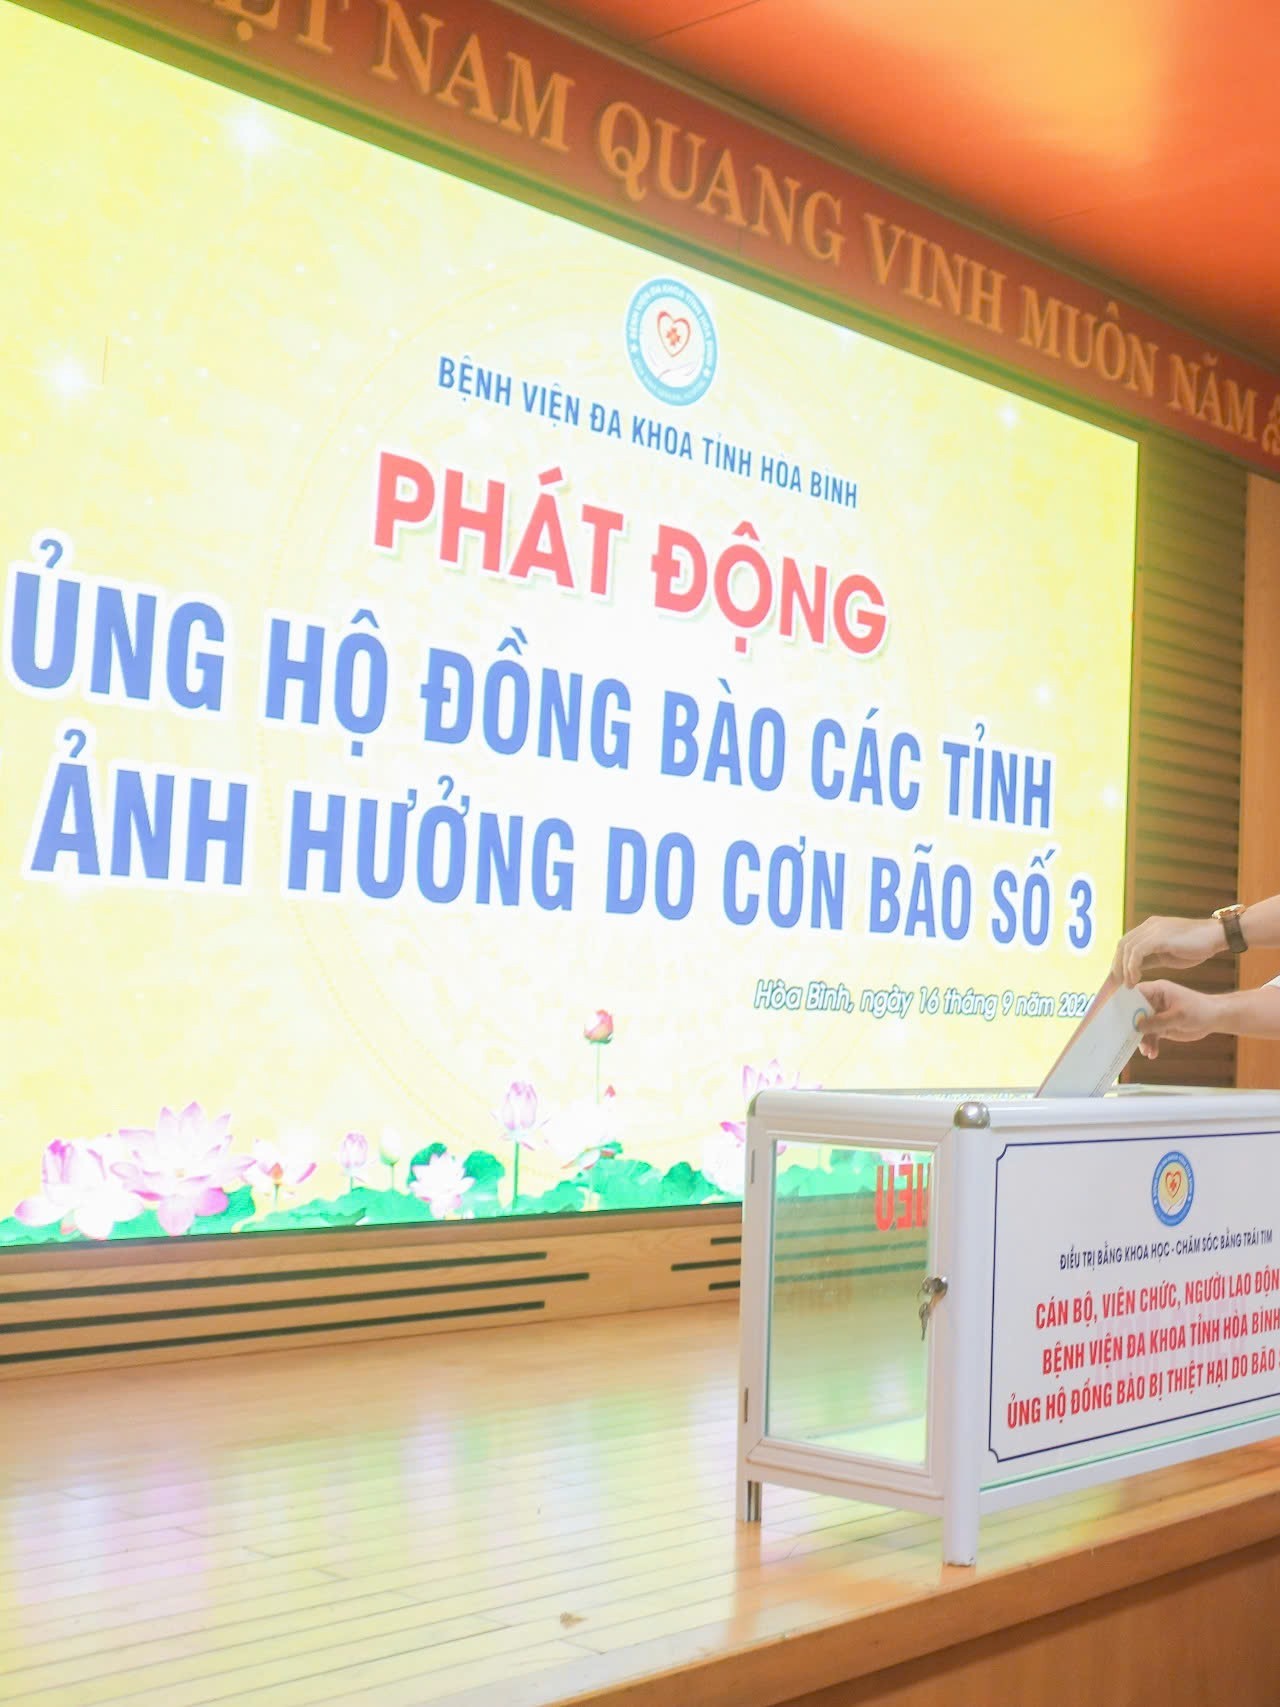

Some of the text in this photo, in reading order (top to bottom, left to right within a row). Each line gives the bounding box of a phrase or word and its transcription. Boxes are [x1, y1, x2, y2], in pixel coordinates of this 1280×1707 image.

[371, 0, 576, 151] NAM
[599, 101, 846, 266] QUANG
[863, 212, 1007, 334] VINH
[1018, 301, 1159, 397] MUÔN
[1168, 351, 1257, 443] NĂM
[438, 354, 858, 509] BỆNH VIỆN ĐA KHOA TỈNH HÒA BÌNH
[374, 452, 887, 654] PHÁT ĐỘNG
[11, 538, 1052, 829] ỦNG HỘ ĐỒNG BÀO CÁC TỈNH
[31, 729, 1092, 949] ẢNH HƯỞNG DO CƠN BÃO SỐ 3
[753, 979, 802, 1010] Hòa
[806, 981, 854, 1013] Bình,
[860, 985, 913, 1018] ngày
[920, 987, 938, 1014] 16
[943, 987, 998, 1022] tháng
[1003, 991, 1014, 1017] 9
[1016, 991, 1054, 1017] năm
[1036, 1296, 1069, 1330] CÁN
[1073, 1290, 1097, 1327] BỘ,
[1103, 1286, 1135, 1319] VIÊN
[1140, 1280, 1181, 1312] CHỨC,
[1185, 1271, 1225, 1306] NGƯỜI
[1229, 1272, 1251, 1298] LAO
[1083, 1250, 1095, 1271] TRỊ
[1124, 1245, 1149, 1262] KHOA
[1151, 1241, 1170, 1263] HỌC
[1202, 1231, 1219, 1252] SÓC
[1243, 1227, 1259, 1246] TRÁI
[1260, 1228, 1273, 1244] TIM
[1007, 1392, 1041, 1429] ỦNG
[1045, 1386, 1066, 1424] HỘ
[1116, 1373, 1145, 1406] BÀO
[1149, 1373, 1164, 1403] BỊ
[1167, 1360, 1203, 1395] THIỆT
[1207, 1362, 1228, 1389] HẠI
[1231, 1353, 1248, 1377] DO
[1251, 1342, 1275, 1375] BÃO
[1042, 1305, 1280, 1379] BỆNH VIỆN ĐA KHOA TỈNH HÒA BÌNH
